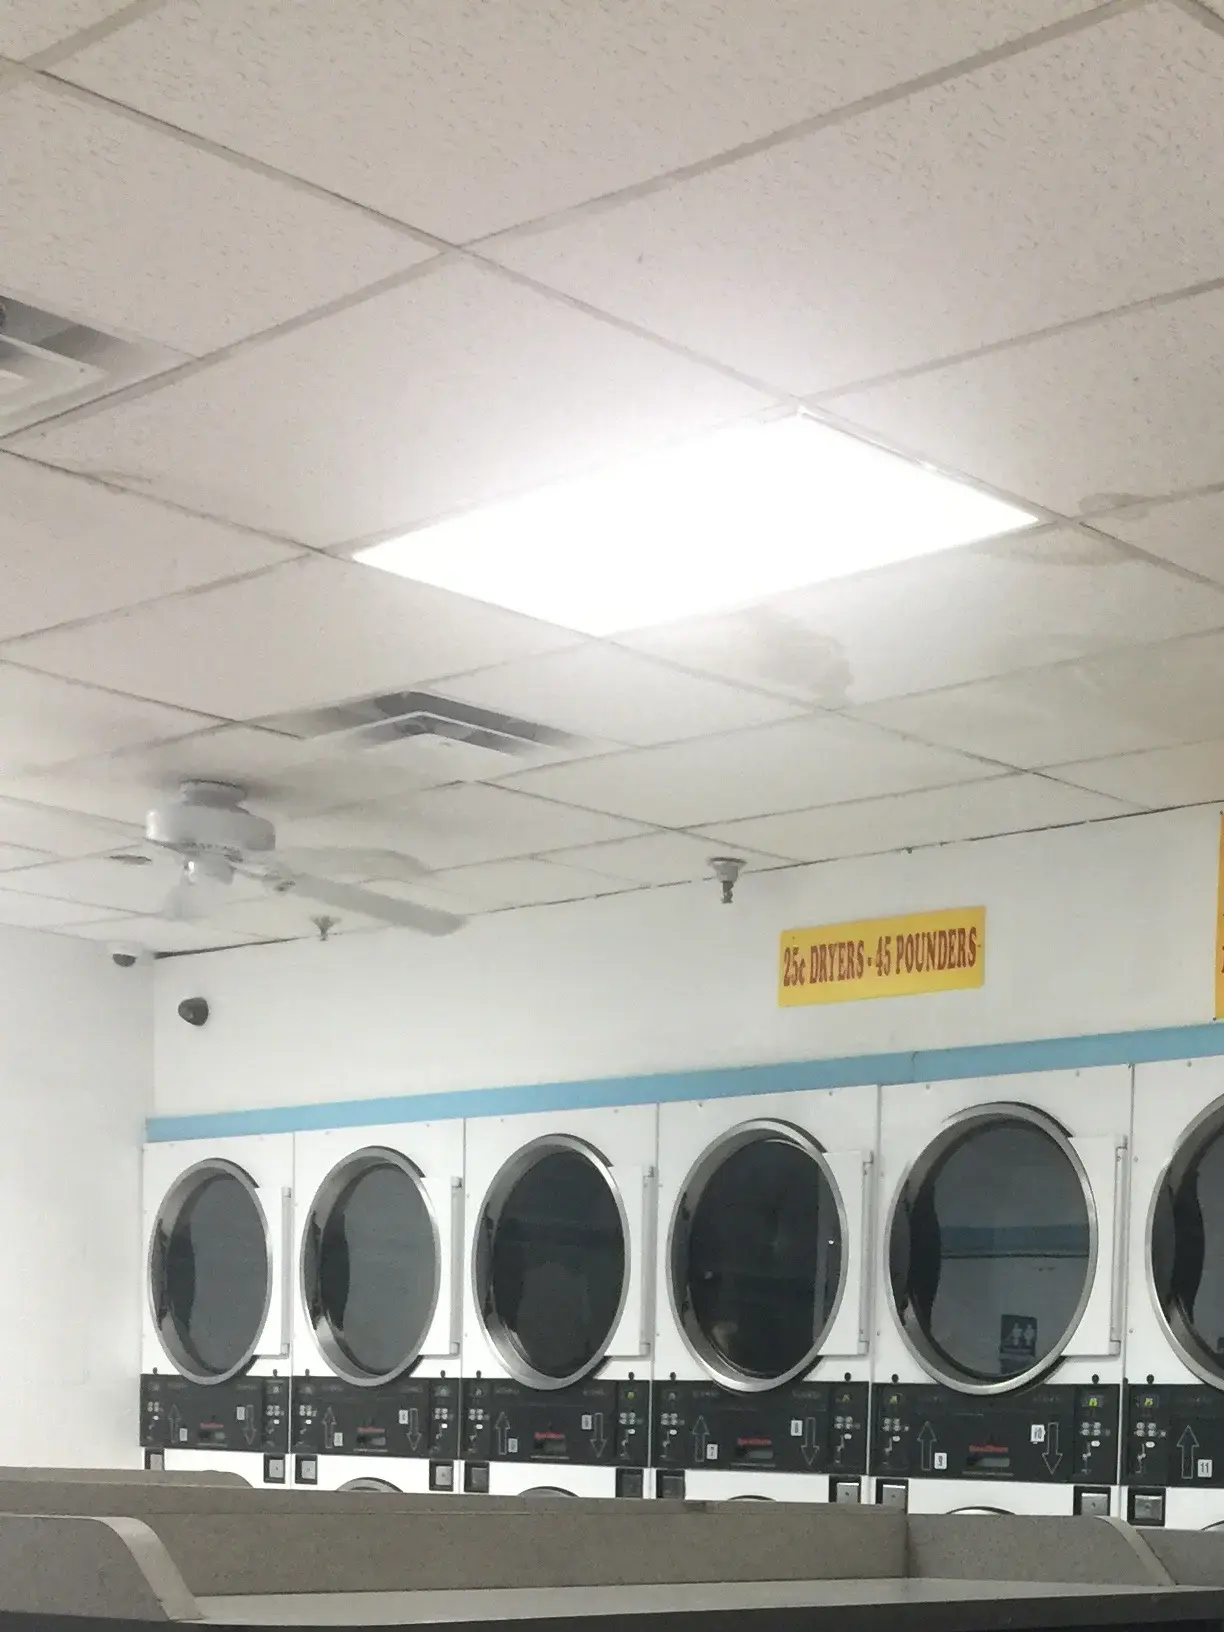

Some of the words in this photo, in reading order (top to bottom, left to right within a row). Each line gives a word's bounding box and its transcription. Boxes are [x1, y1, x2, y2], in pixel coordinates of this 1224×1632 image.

[809, 940, 865, 984] DRYERS
[875, 935, 892, 977] 45
[895, 927, 978, 975] POUNDERS
